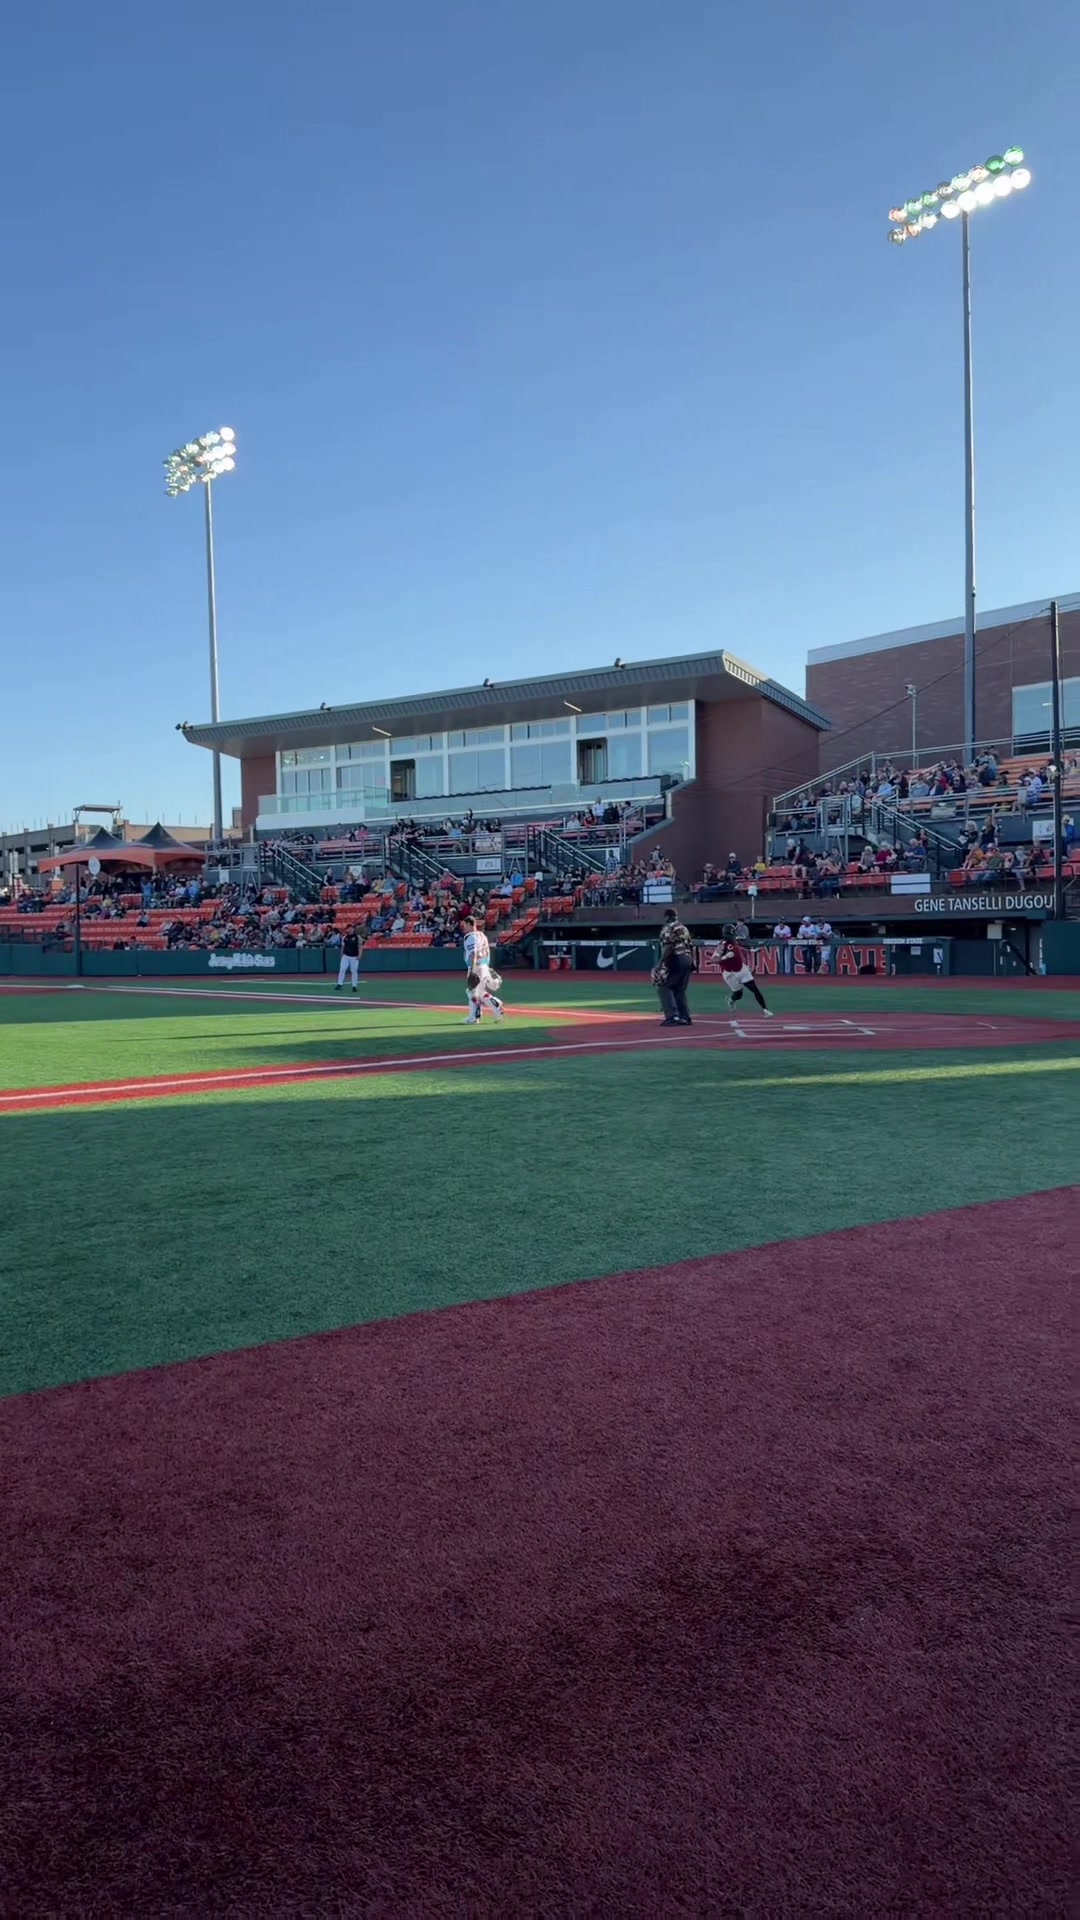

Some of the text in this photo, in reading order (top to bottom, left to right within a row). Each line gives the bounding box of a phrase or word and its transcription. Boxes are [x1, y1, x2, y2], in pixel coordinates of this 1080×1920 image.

[914, 894, 1056, 912] GENE TANSELLI DUGOU
